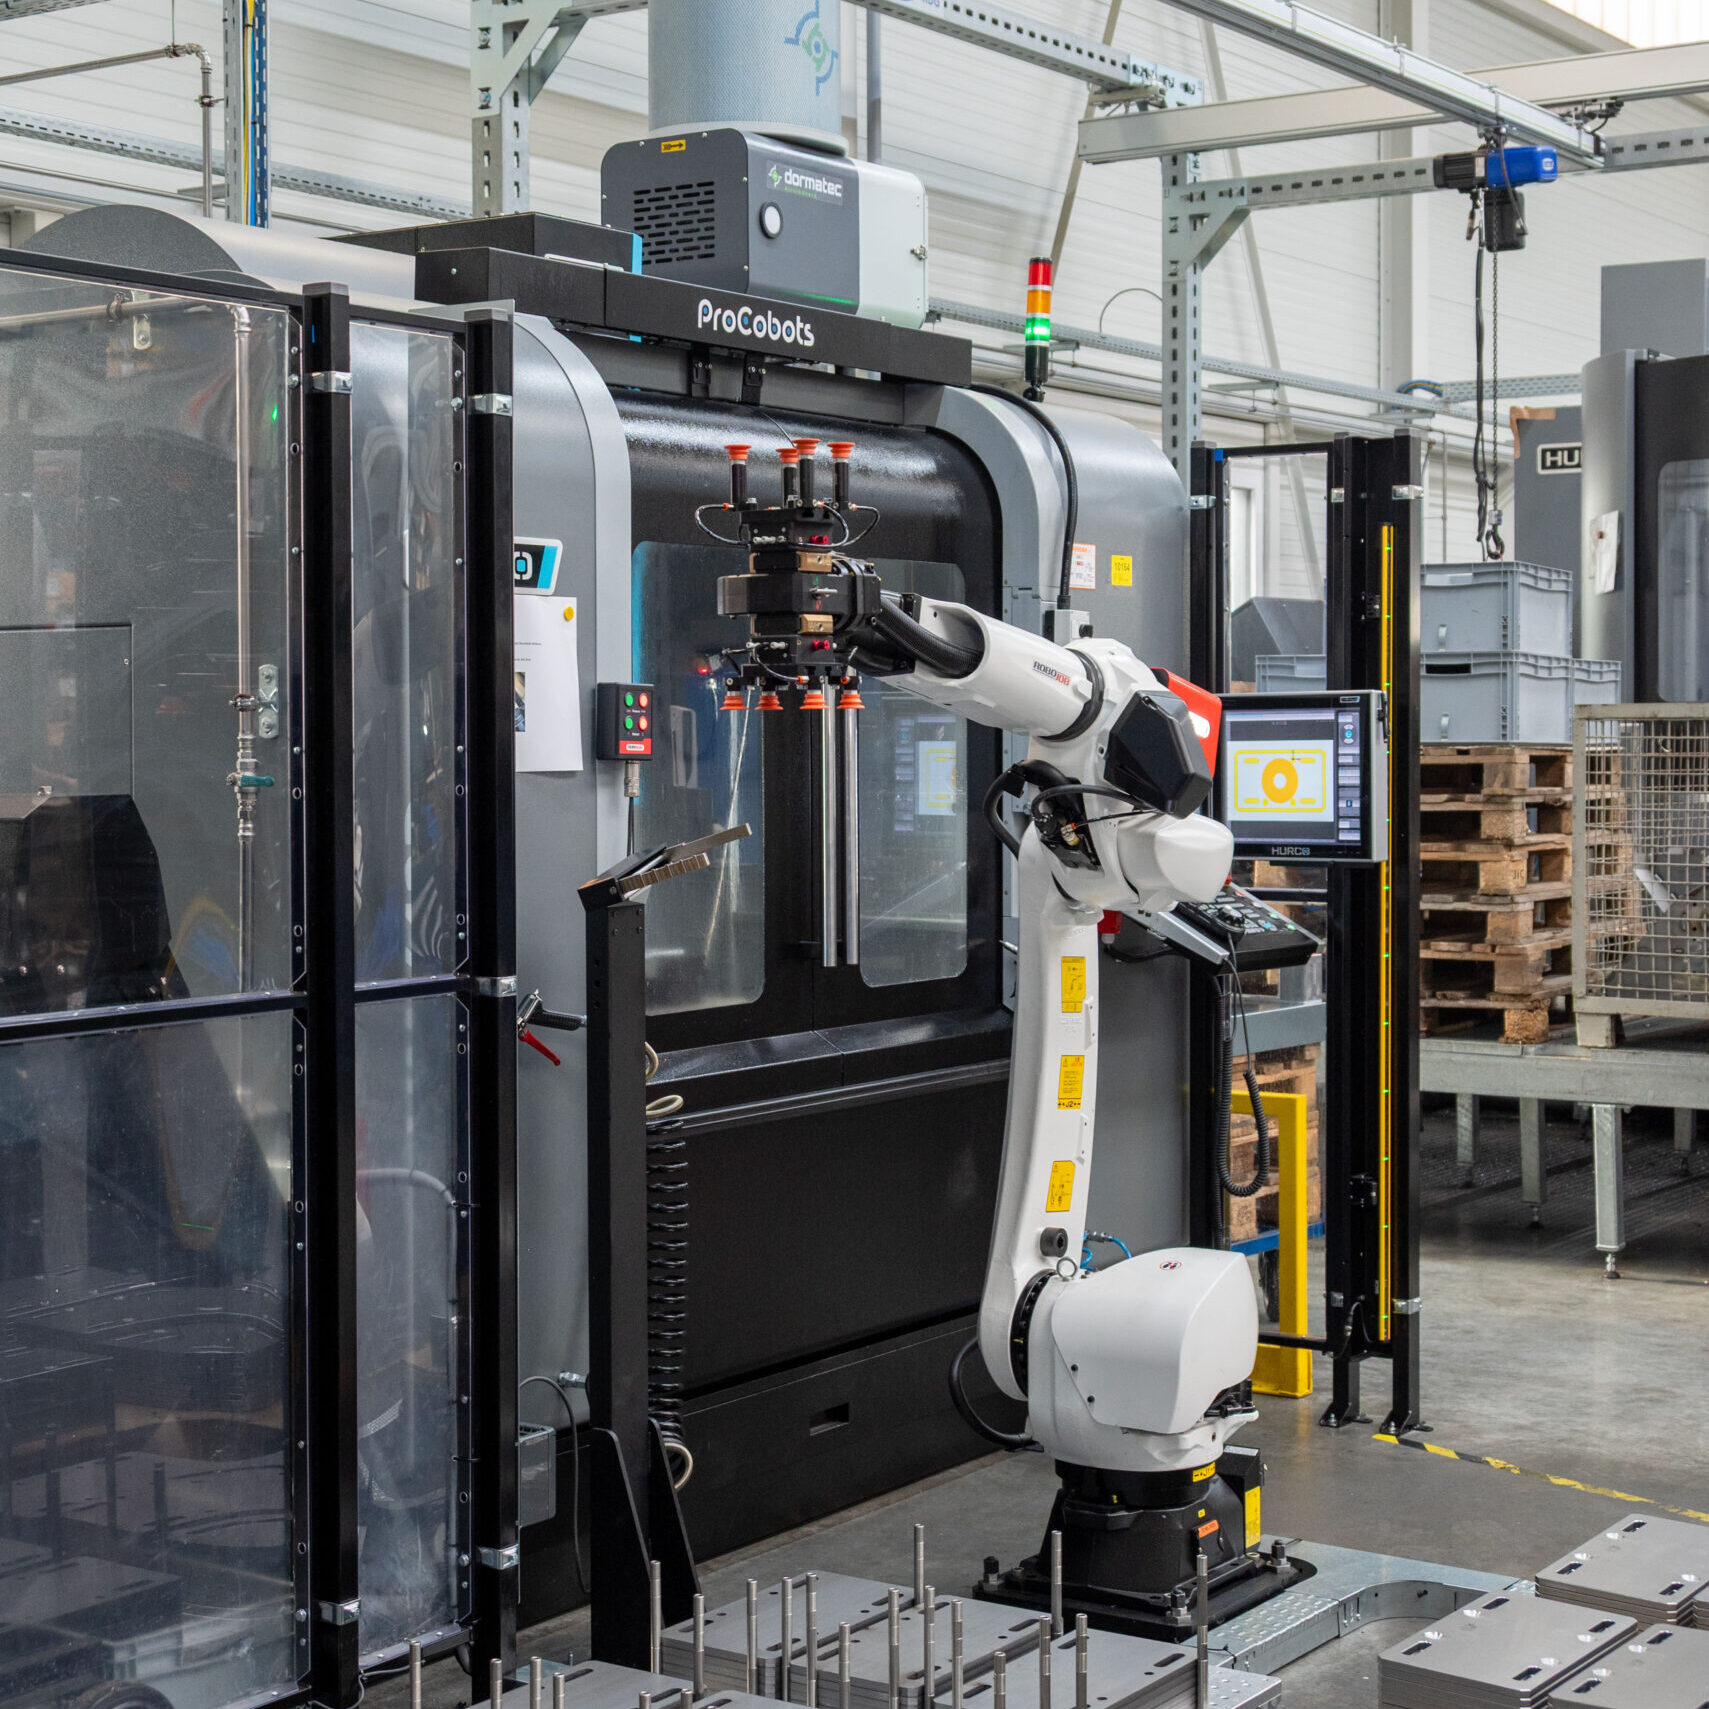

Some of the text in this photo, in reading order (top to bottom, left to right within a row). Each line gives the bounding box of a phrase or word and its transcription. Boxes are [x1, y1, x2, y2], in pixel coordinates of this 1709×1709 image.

[784, 168, 842, 197] dormatec
[697, 298, 815, 347] ProCobots
[1032, 660, 1071, 686] ROBOJOB
[1271, 846, 1311, 856] HURCO
